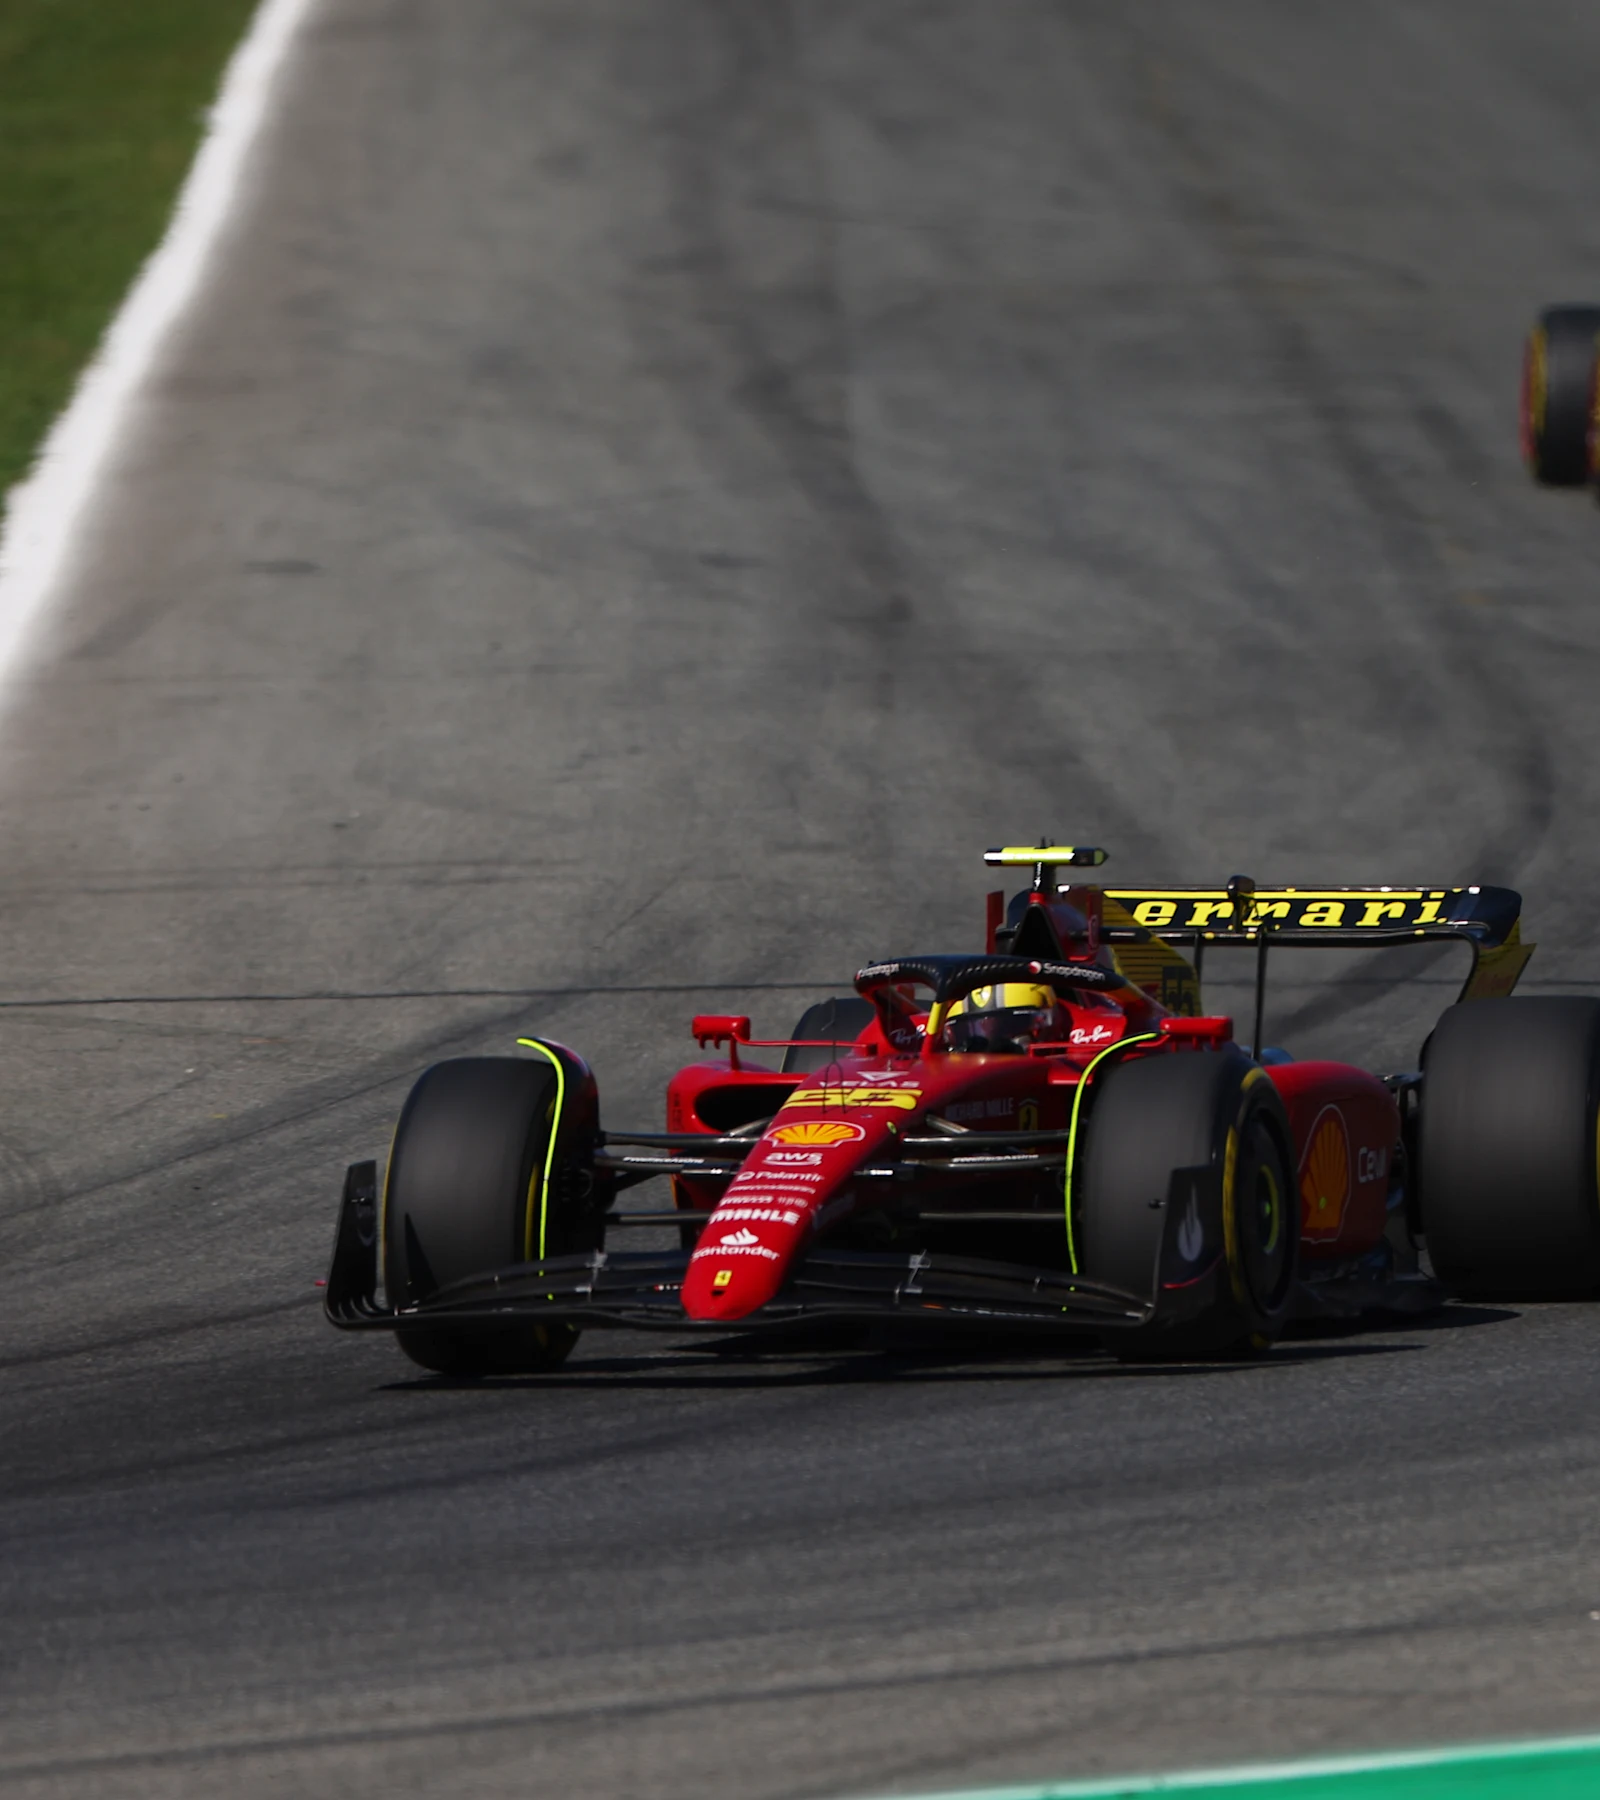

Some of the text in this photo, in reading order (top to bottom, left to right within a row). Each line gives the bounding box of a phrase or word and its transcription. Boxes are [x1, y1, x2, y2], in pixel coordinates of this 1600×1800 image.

[1103, 890, 1448, 928] errari
[1043, 963, 1106, 982] Snapdragon
[778, 1088, 923, 1111] 55
[766, 1151, 823, 1162] aws
[755, 1170, 824, 1183] Palantir
[709, 1208, 801, 1226] MAHLE
